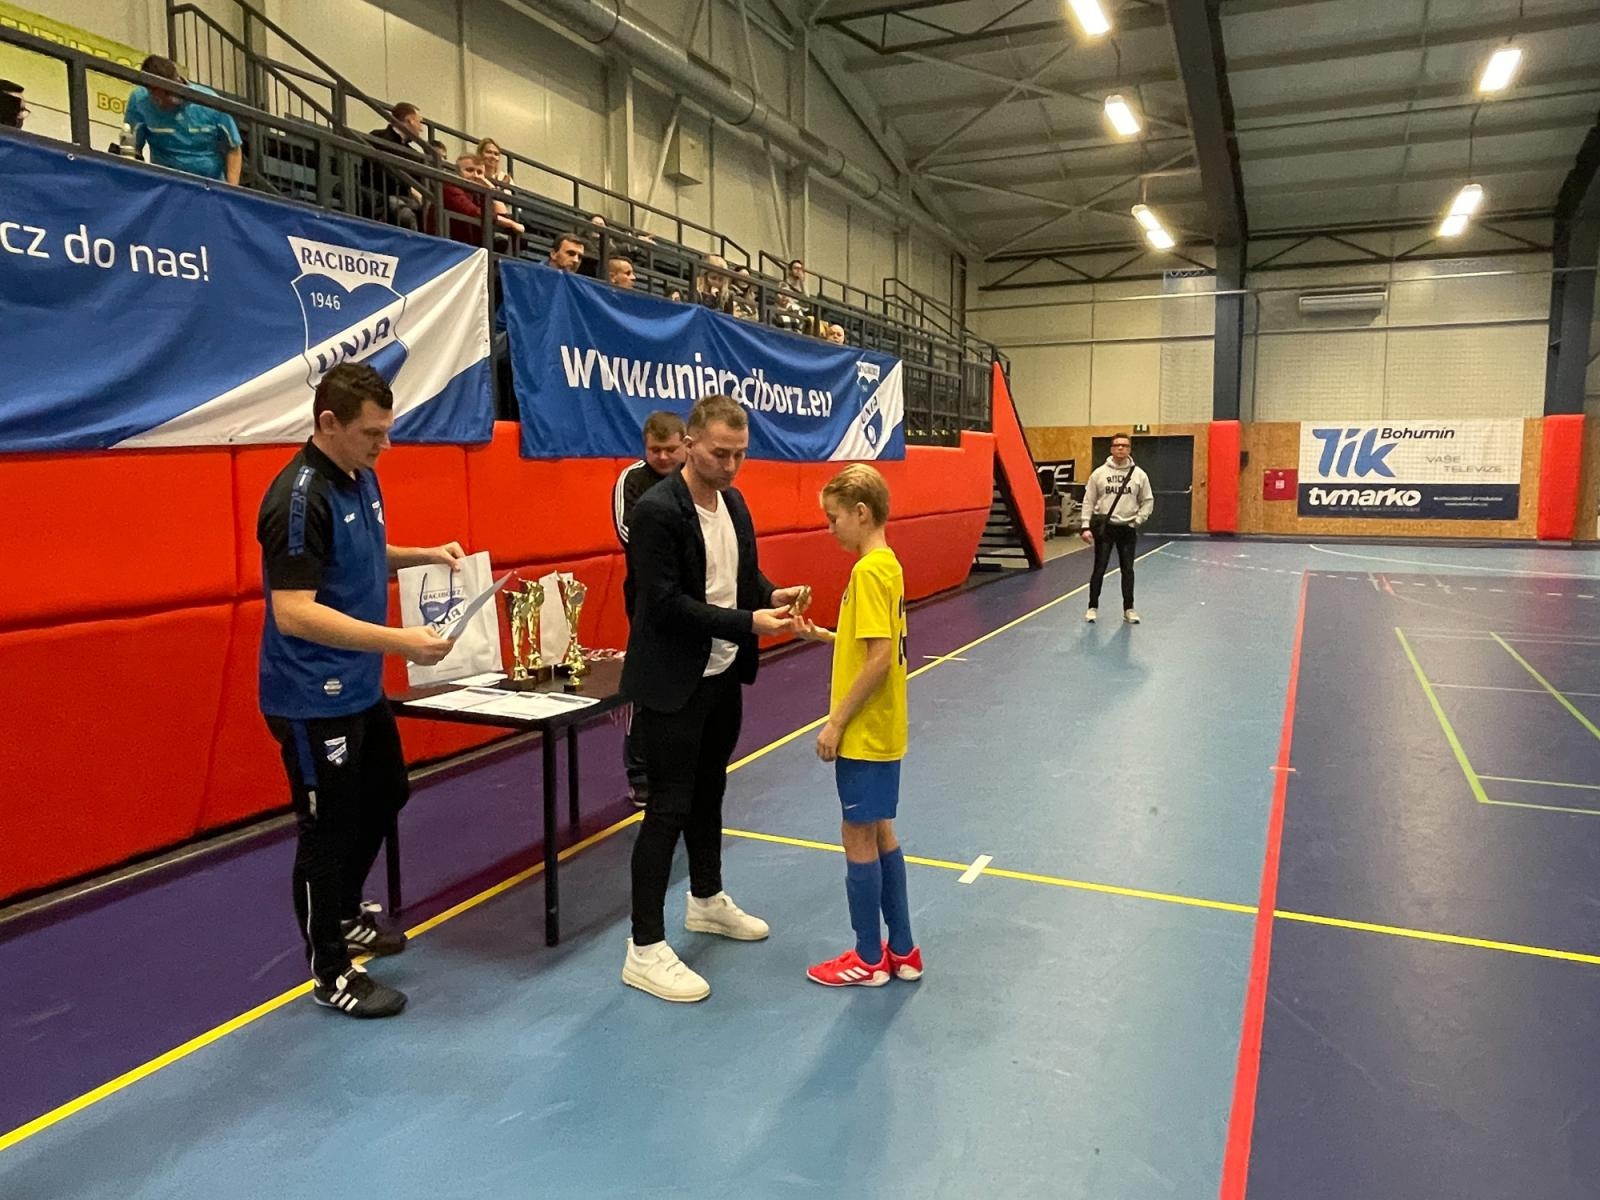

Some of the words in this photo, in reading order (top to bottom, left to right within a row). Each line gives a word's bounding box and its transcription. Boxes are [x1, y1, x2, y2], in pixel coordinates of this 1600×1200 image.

[64, 224, 115, 269] do
[129, 244, 209, 282] nas!
[301, 246, 390, 278] RACIBÓRZ
[310, 292, 341, 310] 1946
[316, 316, 390, 373] UNIA
[560, 345, 832, 418] www.uniaraciborz.eu
[1308, 487, 1422, 507] tvmarko
